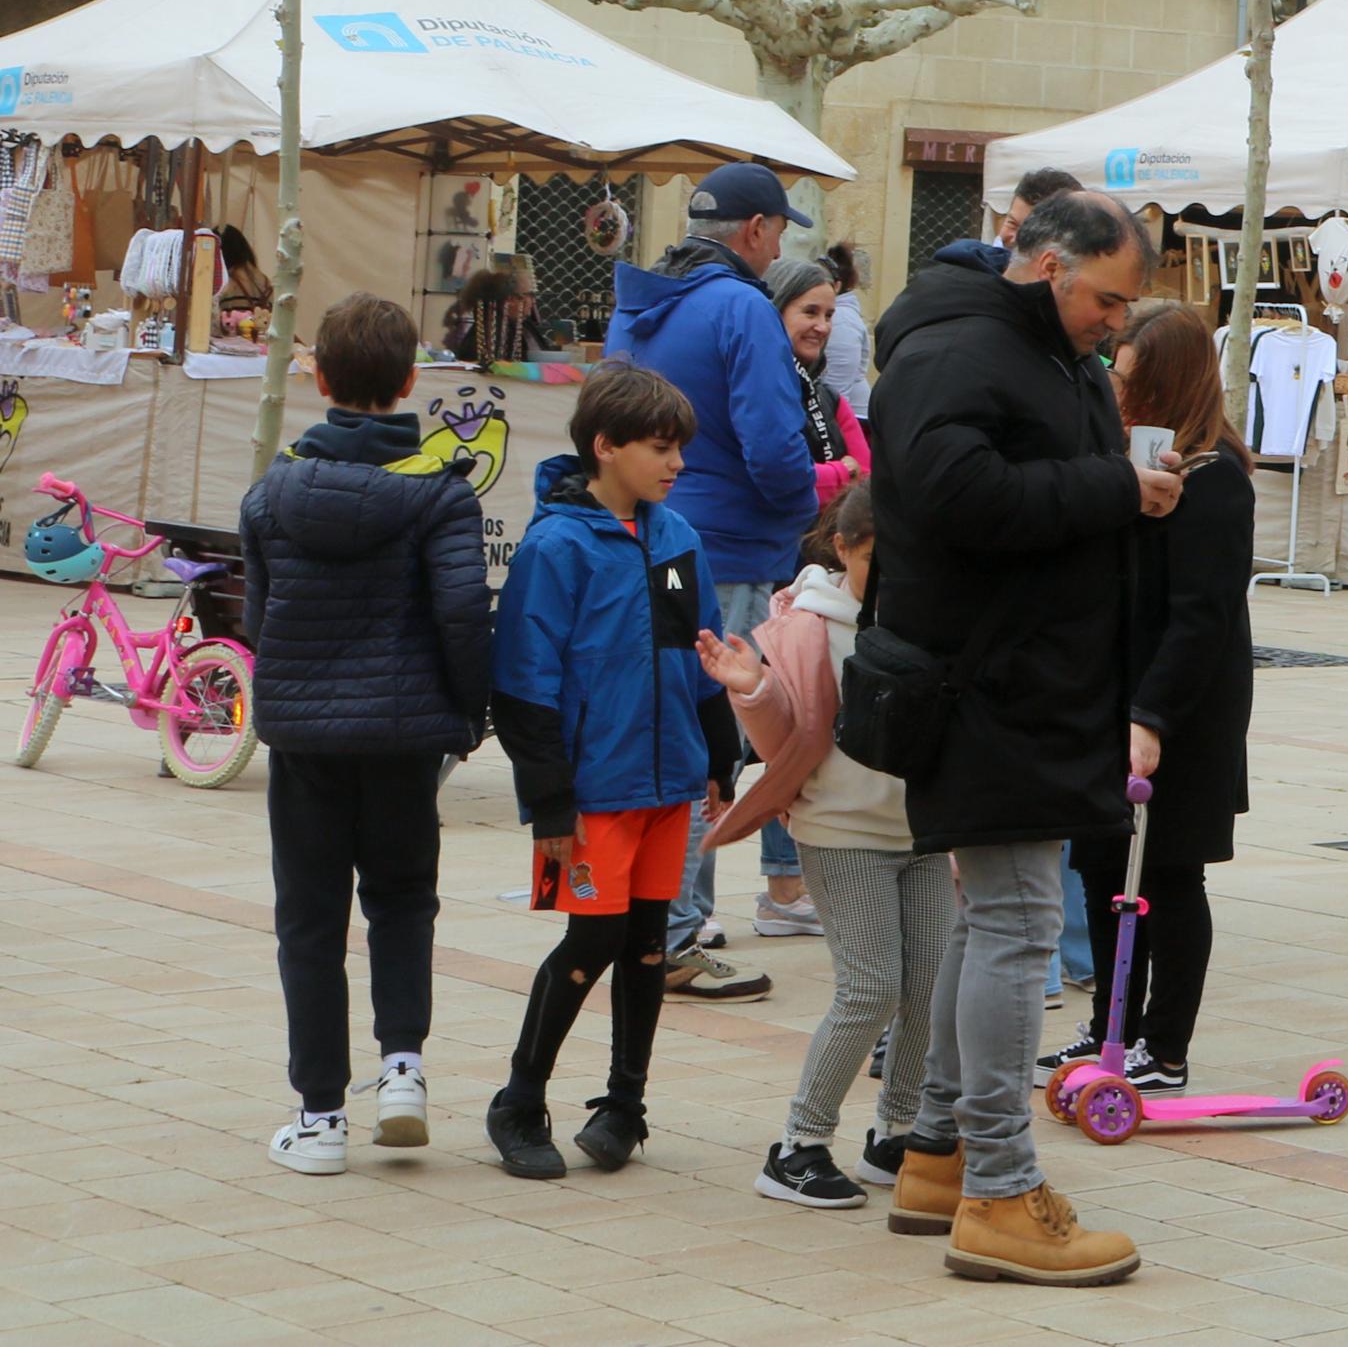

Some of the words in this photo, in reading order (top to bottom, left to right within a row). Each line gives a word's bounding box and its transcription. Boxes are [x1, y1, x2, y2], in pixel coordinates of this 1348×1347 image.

[416, 18, 552, 48] Diputación
[430, 35, 473, 48] DE
[477, 36, 599, 69] PALENCIA
[1139, 153, 1192, 165] Diputación
